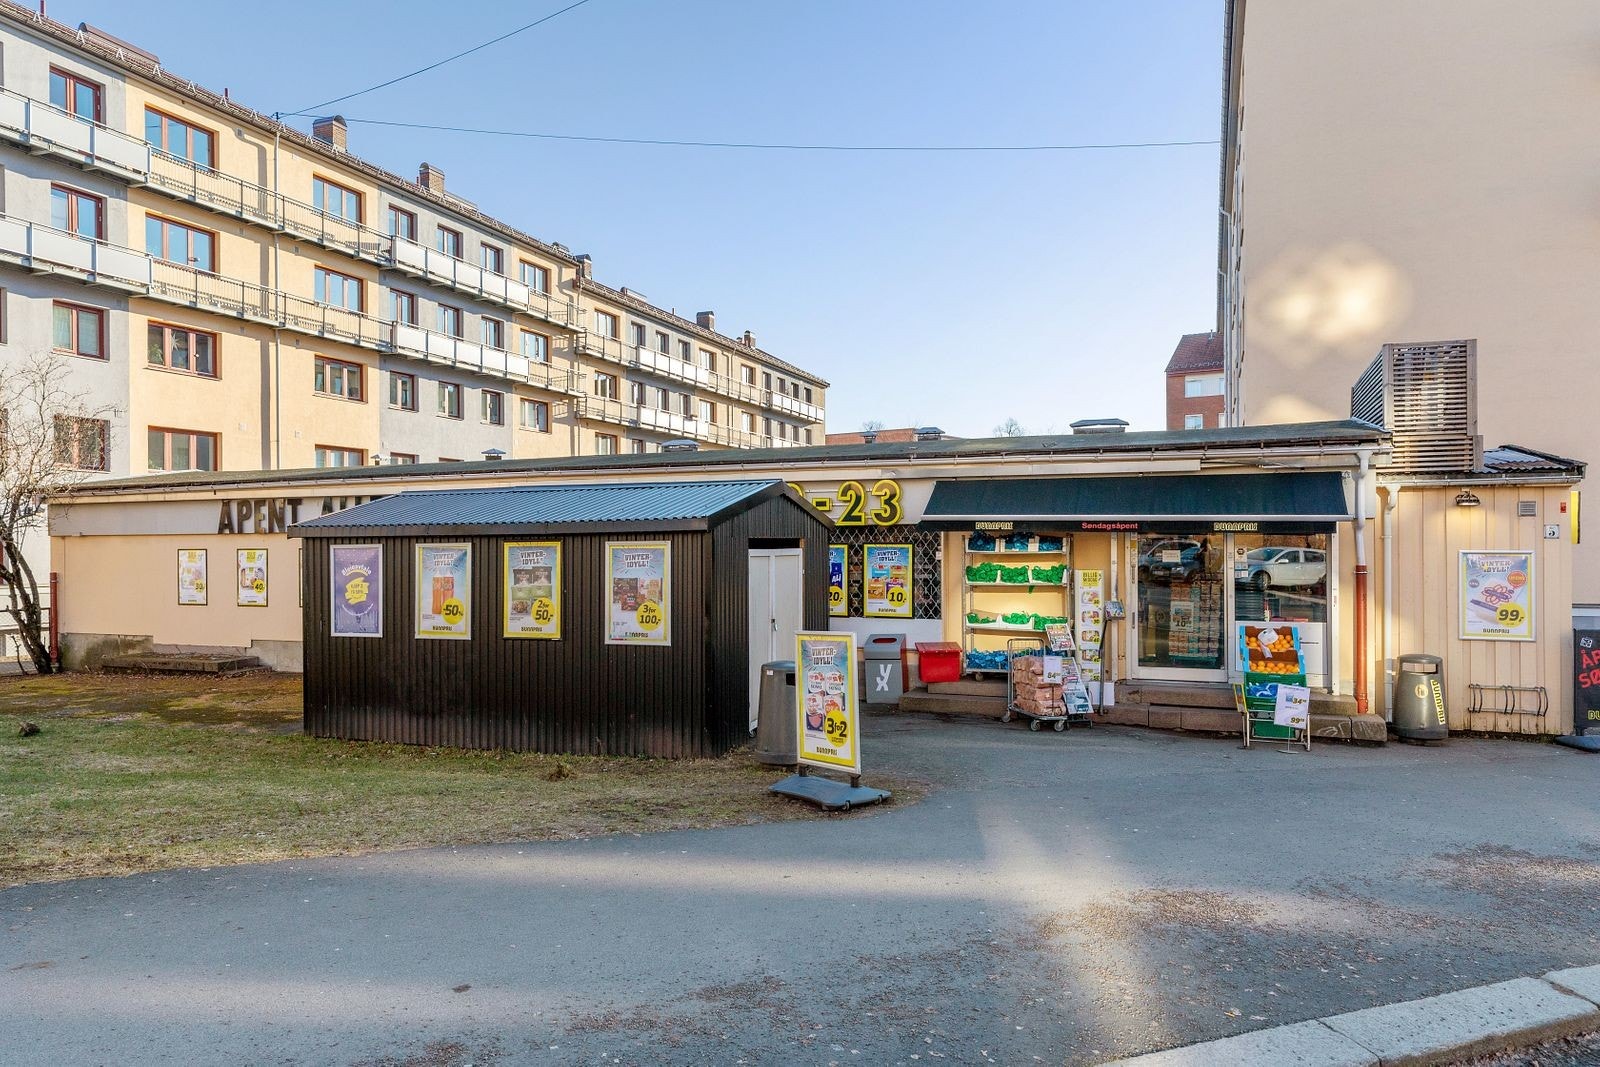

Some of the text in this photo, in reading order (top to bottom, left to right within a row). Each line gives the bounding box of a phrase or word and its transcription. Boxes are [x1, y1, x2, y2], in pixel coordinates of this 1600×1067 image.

[790, 480, 904, 526] -23
[1081, 521, 1139, 531] Søndagsåpent
[520, 550, 547, 560] VINTER-
[624, 553, 652, 561] VINTER-
[626, 560, 649, 568] IDYLL!
[889, 592, 907, 603] 10,-
[535, 609, 553, 622] 50,-
[639, 614, 661, 625] 100,-
[1498, 609, 1524, 623] 99,-
[812, 647, 836, 657] VINTER-
[813, 656, 833, 666] IDYLL!
